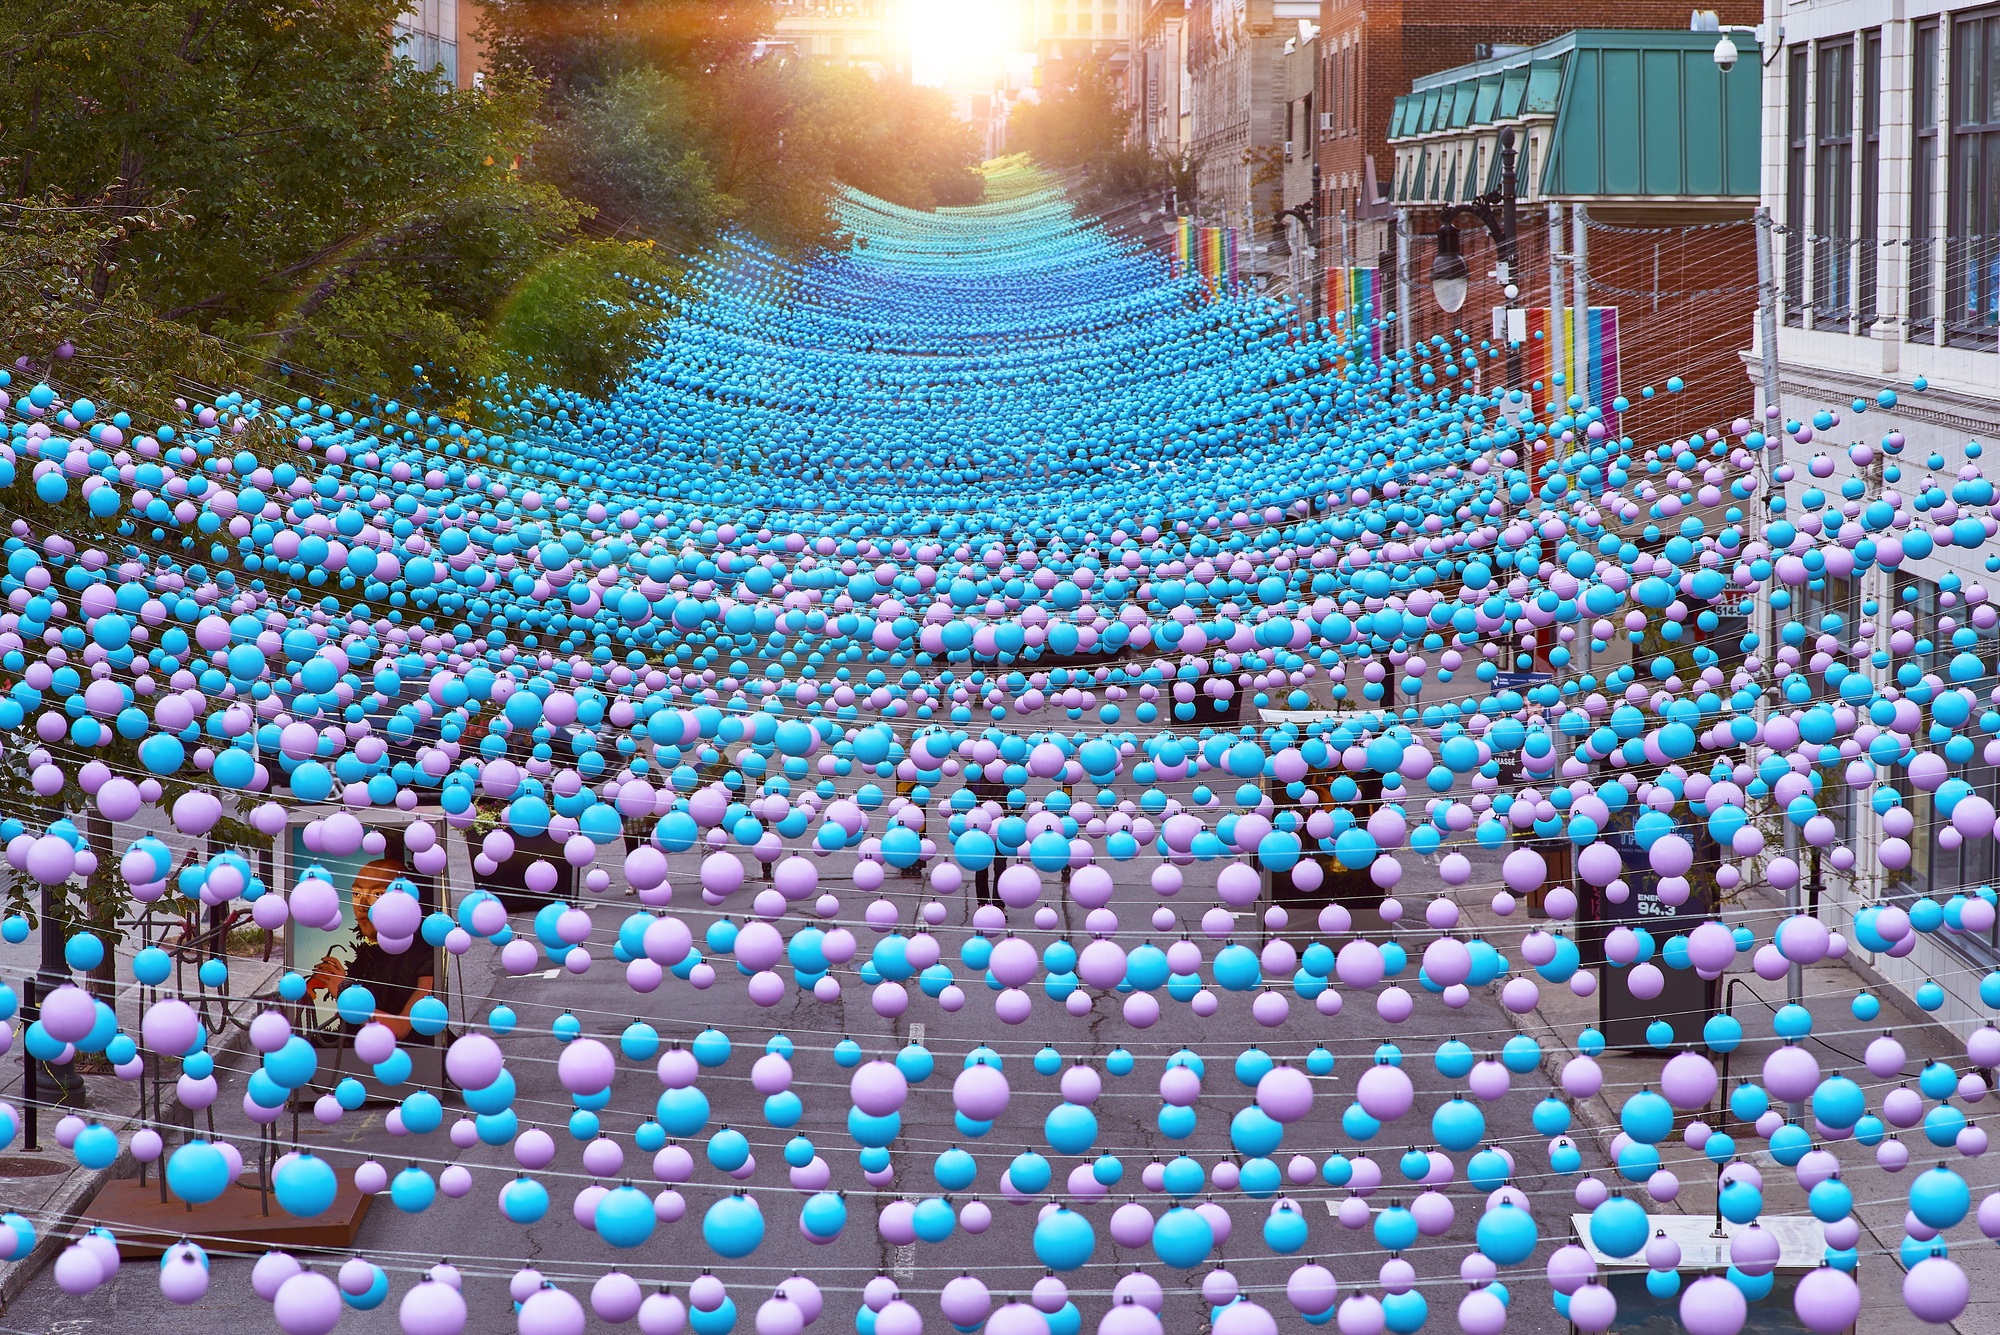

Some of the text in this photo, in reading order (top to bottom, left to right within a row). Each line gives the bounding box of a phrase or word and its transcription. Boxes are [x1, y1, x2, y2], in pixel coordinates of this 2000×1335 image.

[1149, 79, 1158, 124] DAGISCO
[1716, 606, 1743, 616] 514-5
[1637, 901, 1676, 916] 94.3
